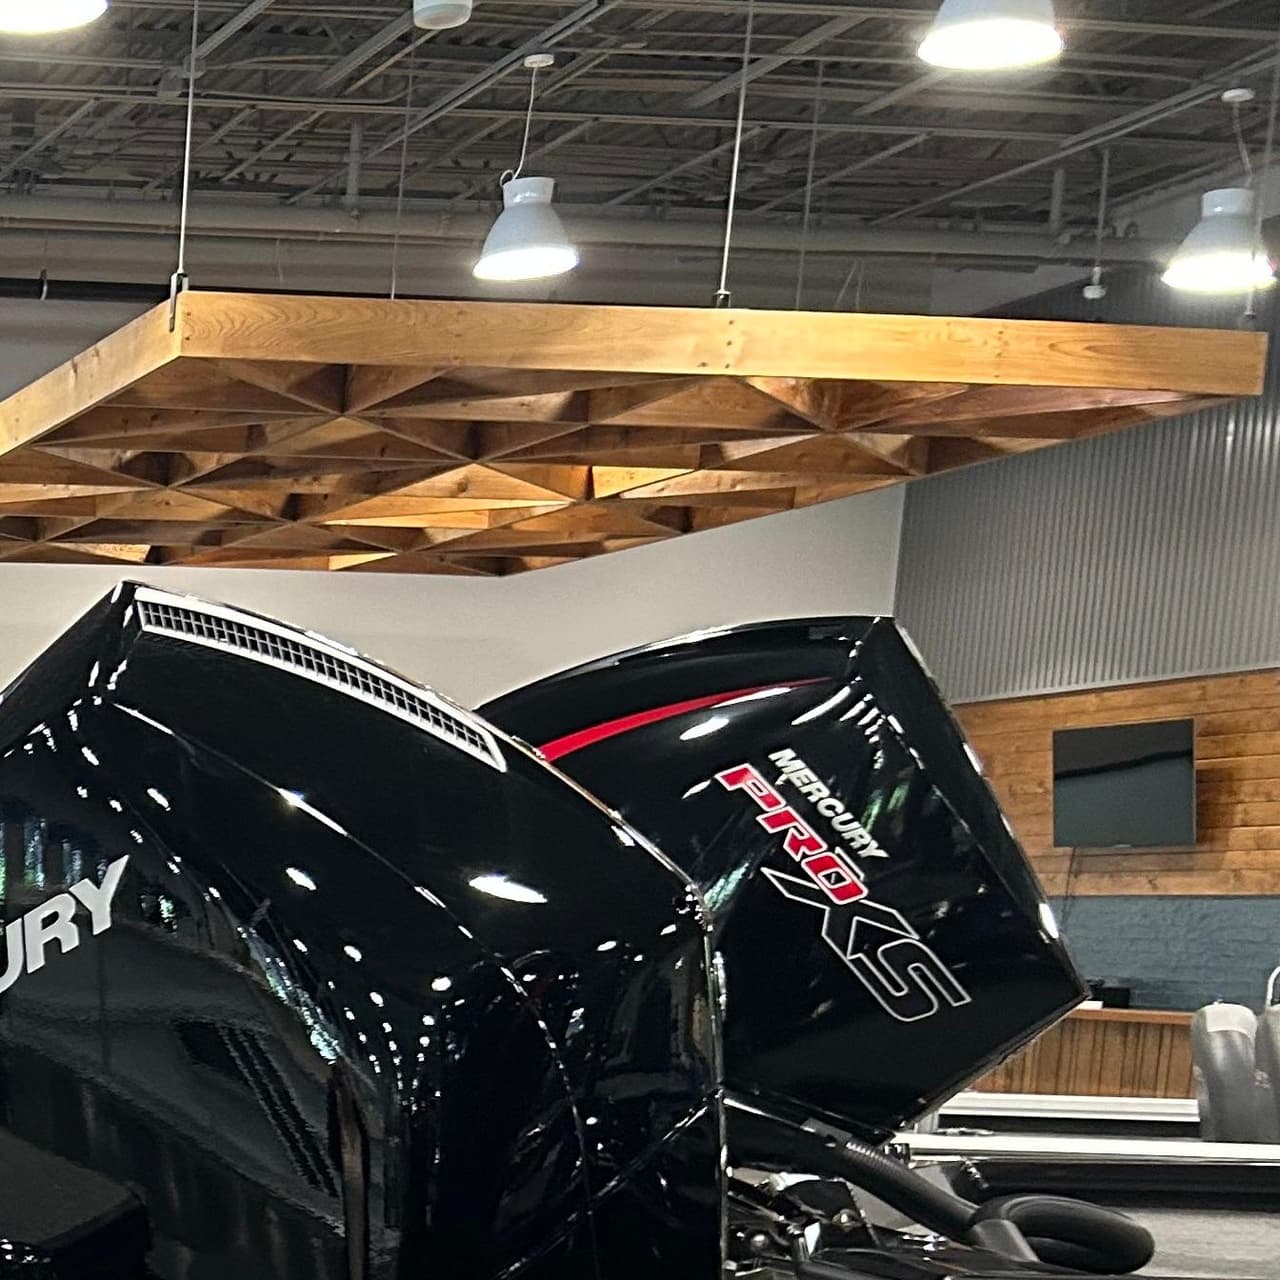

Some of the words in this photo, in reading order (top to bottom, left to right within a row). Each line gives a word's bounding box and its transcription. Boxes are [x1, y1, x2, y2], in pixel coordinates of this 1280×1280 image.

[715, 763, 869, 905] PRO
[768, 748, 889, 858] MERCURY
[760, 846, 972, 1022] XS
